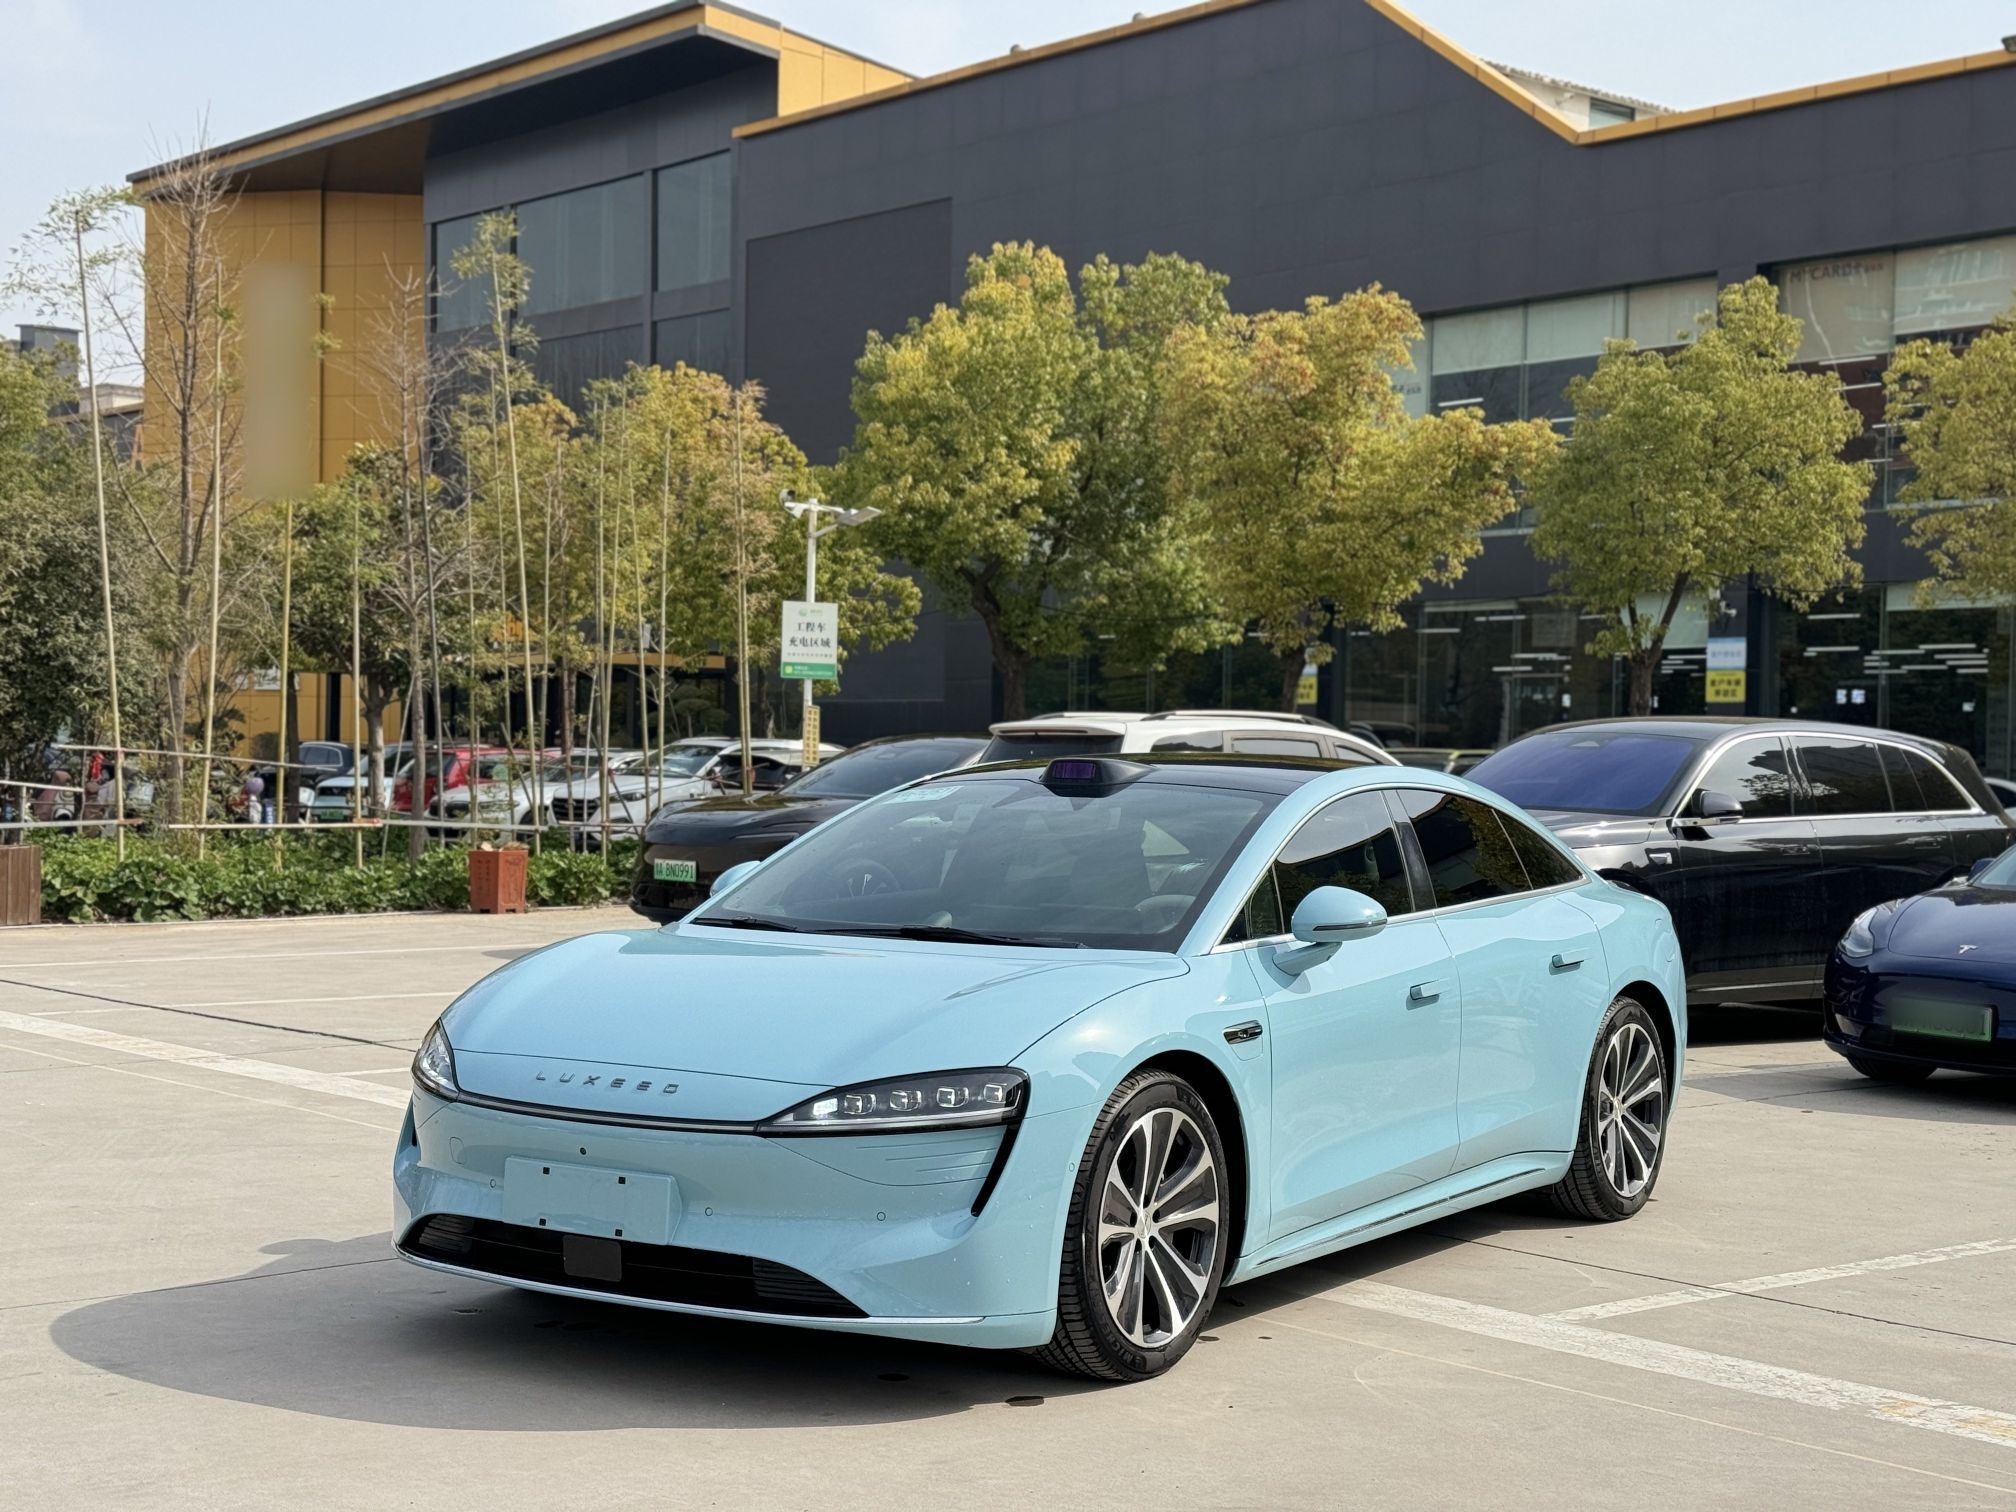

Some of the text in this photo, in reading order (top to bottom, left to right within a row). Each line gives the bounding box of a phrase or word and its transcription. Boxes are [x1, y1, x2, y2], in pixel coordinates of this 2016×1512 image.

[796, 622, 827, 633] 工程车
[789, 636, 831, 648] 充电区域
[536, 1071, 679, 1094] LUXEED
